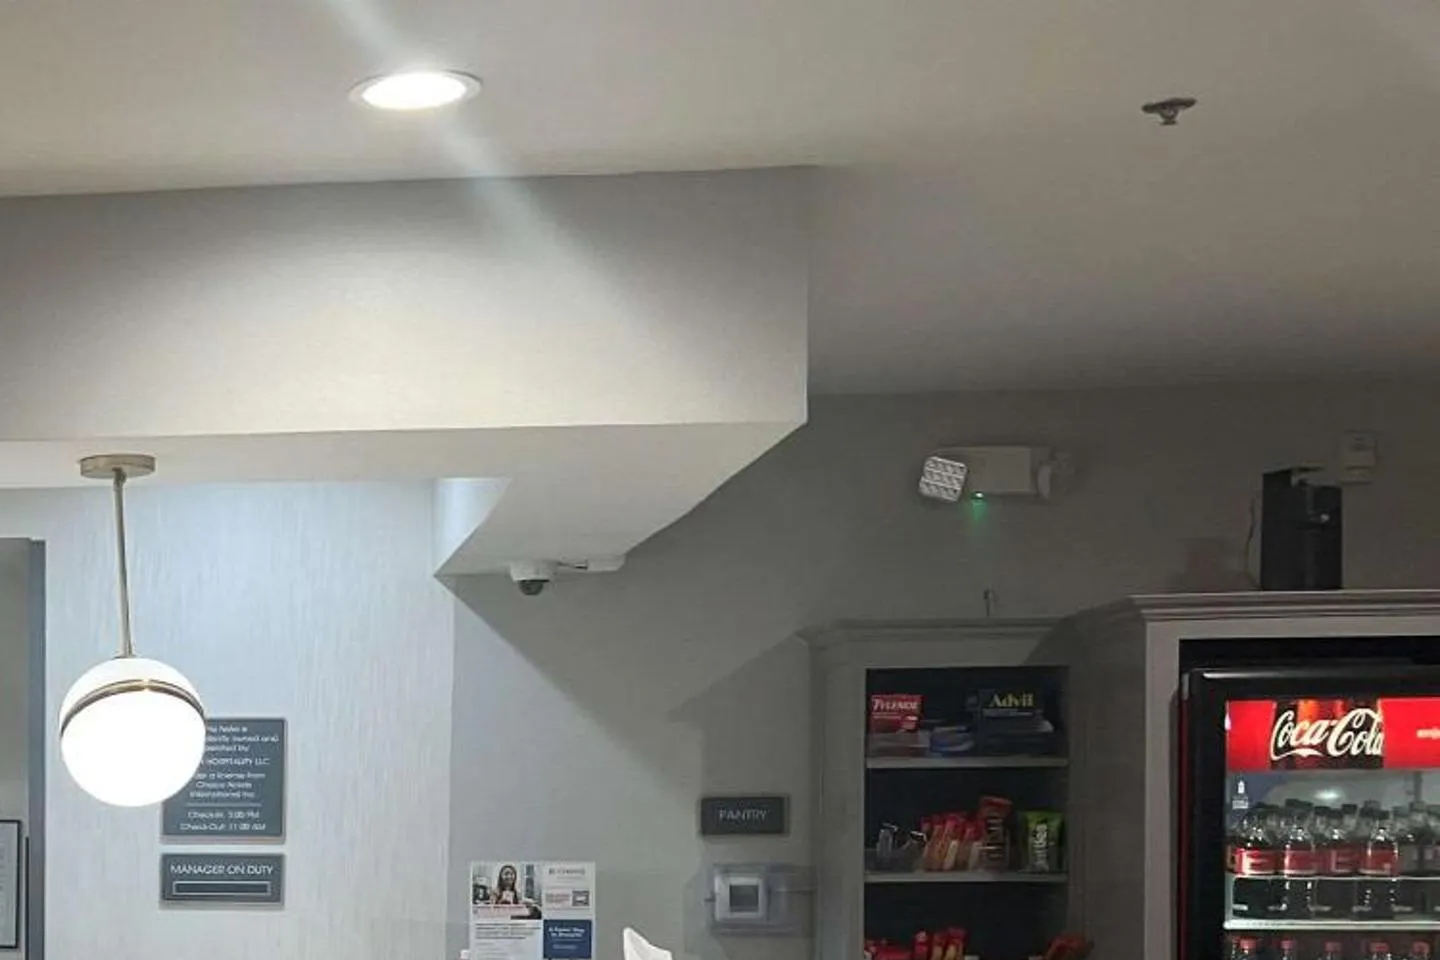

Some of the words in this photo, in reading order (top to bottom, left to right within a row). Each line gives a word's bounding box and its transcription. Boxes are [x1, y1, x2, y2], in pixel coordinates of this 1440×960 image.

[988, 693, 1034, 708] Advil
[1270, 707, 1385, 761] Coca-Cola
[718, 808, 768, 821] PANTRY
[170, 863, 225, 875] MANAGER
[226, 863, 246, 875] ON
[246, 863, 274, 875] DUTY
